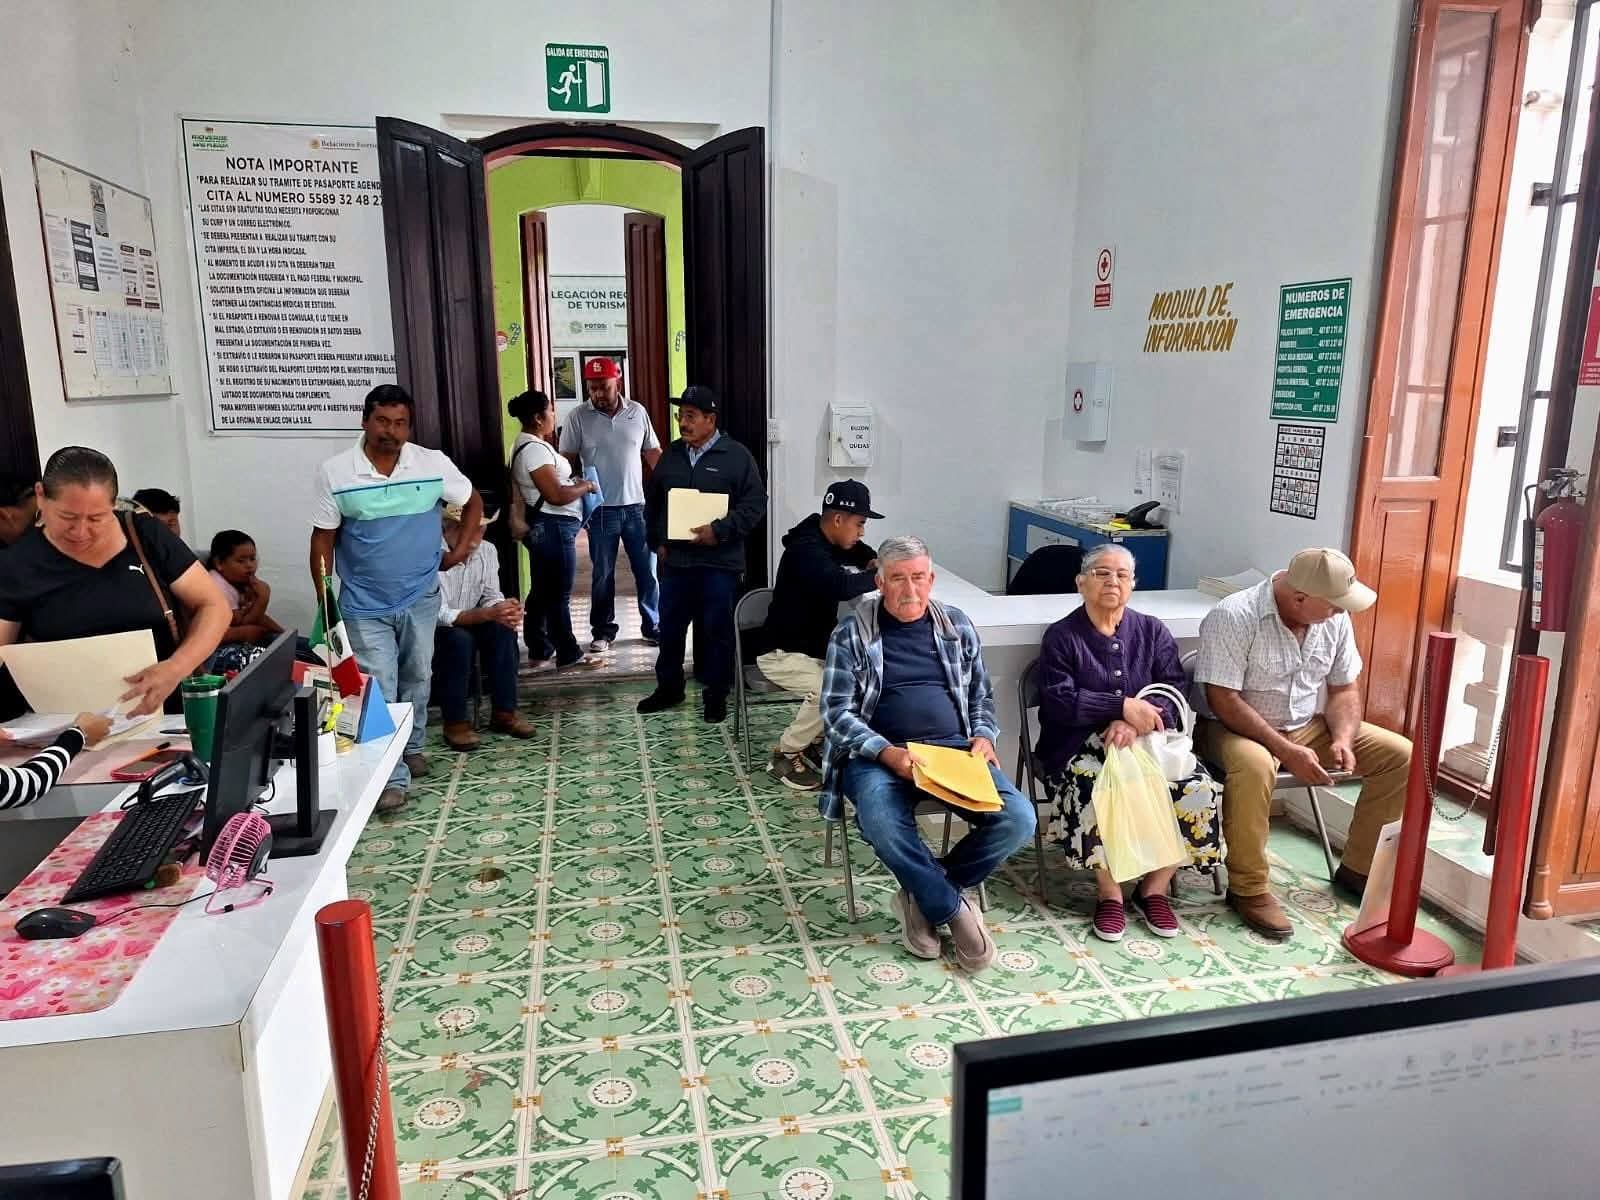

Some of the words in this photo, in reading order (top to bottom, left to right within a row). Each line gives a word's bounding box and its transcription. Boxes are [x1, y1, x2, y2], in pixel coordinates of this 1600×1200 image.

[546, 48, 565, 56] SALIDA
[566, 48, 574, 57] DE
[574, 48, 608, 58] EMERGENCIA
[226, 157, 264, 170] NOTA
[269, 158, 358, 173] IMPORTANTE
[221, 176, 256, 186] REALIZAR
[258, 177, 267, 186] SU
[270, 178, 300, 187] TRAMITE
[303, 179, 312, 187] DE
[314, 179, 355, 189] PASAPORTE
[207, 190, 233, 201] CITA
[237, 191, 252, 201] AL
[256, 192, 305, 203] NUMERO
[309, 193, 336, 204] 5589
[340, 194, 352, 204] 32
[356, 195, 369, 205] 48
[552, 288, 606, 299] LEGACIÓN
[1286, 289, 1330, 304] NUMEROS
[1332, 288, 1345, 300] DE
[585, 301, 625, 309] TURISM
[1148, 286, 1207, 320] MODULO
[1284, 305, 1343, 320] EMERGENCIA
